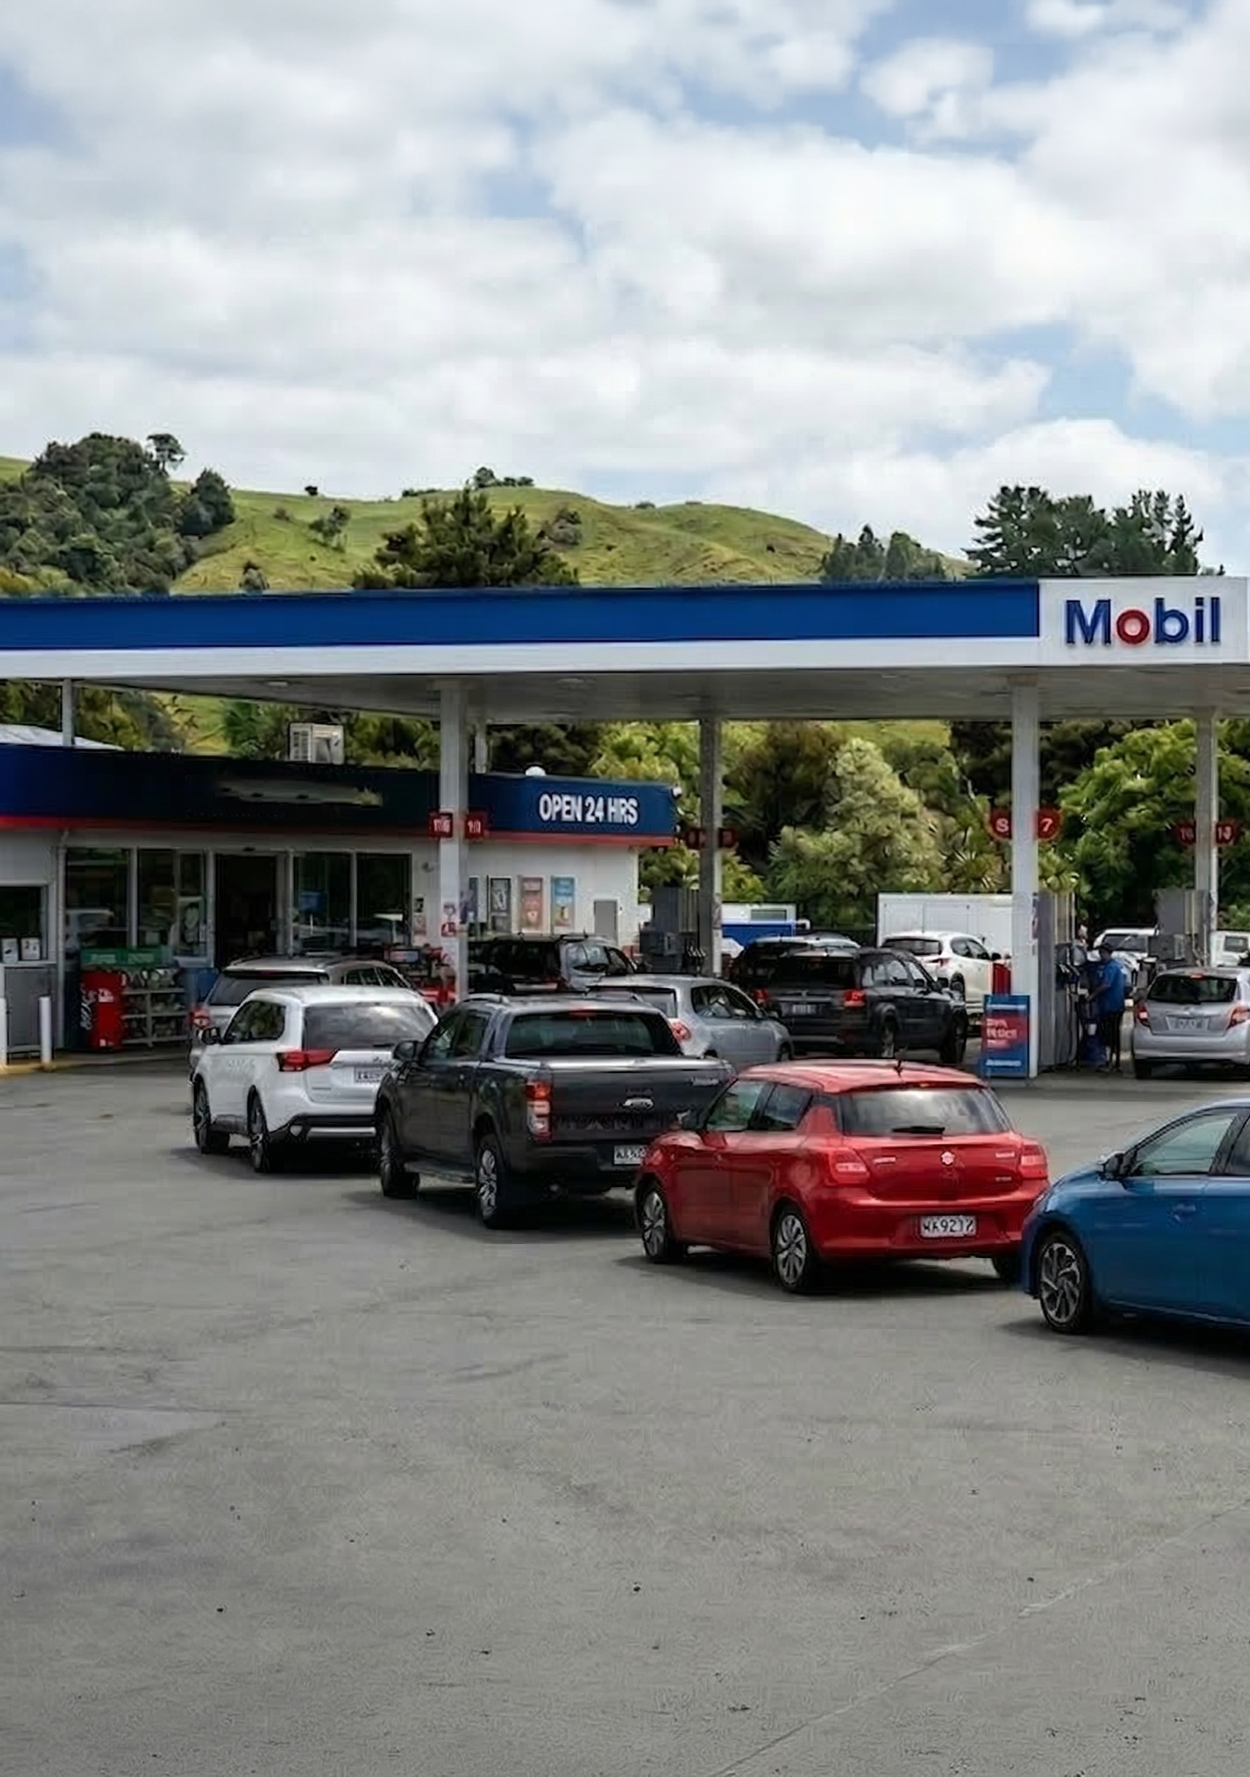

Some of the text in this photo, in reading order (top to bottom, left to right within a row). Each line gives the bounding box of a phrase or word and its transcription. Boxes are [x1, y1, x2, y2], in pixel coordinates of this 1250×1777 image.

[1066, 597, 1220, 644] Mobil
[539, 793, 639, 825] OPEN 24 HRS
[1041, 817, 1054, 832] 7
